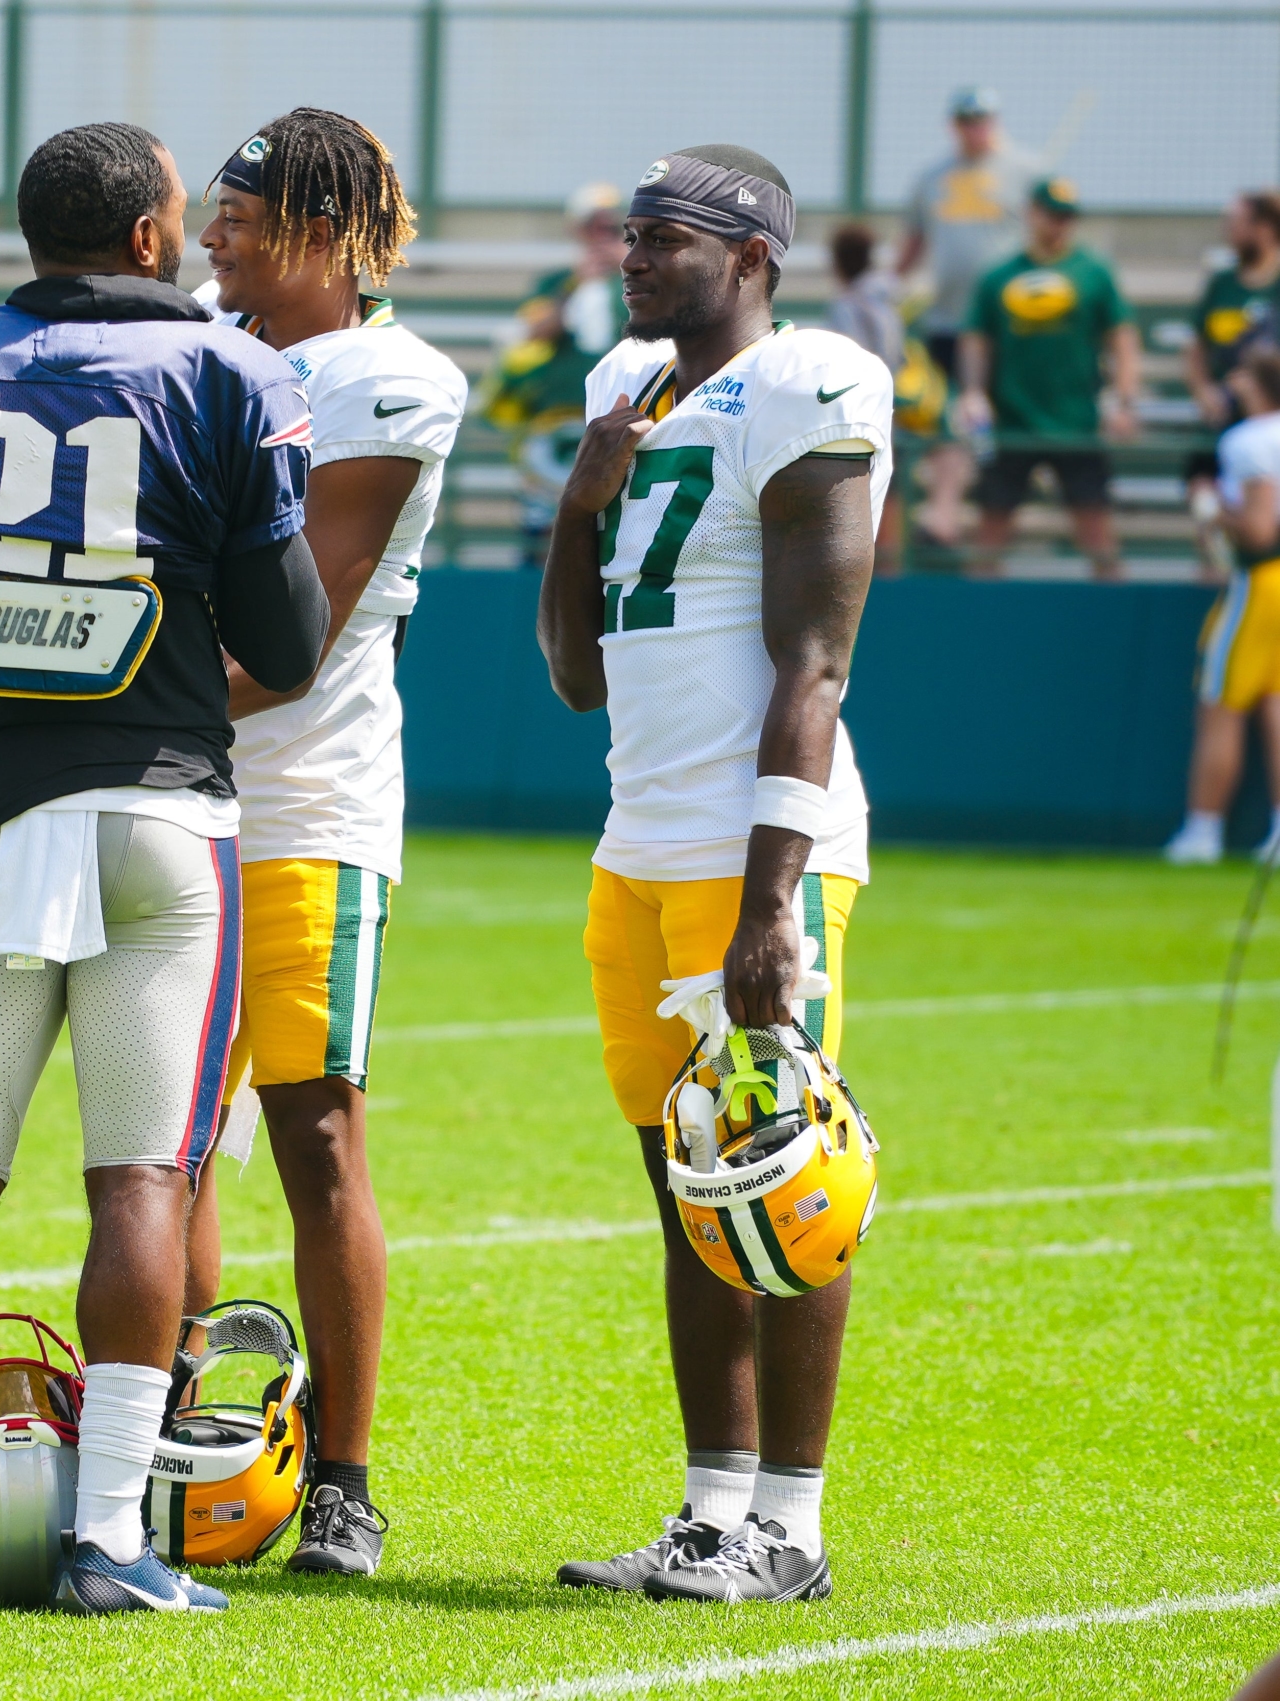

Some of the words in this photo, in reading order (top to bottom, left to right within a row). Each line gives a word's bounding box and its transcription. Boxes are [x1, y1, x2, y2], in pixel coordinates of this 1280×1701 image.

[694, 376, 744, 397] bellin
[700, 395, 746, 416] health
[733, 1164, 786, 1194] INSPIRE
[685, 1185, 732, 1199] CHANGE
